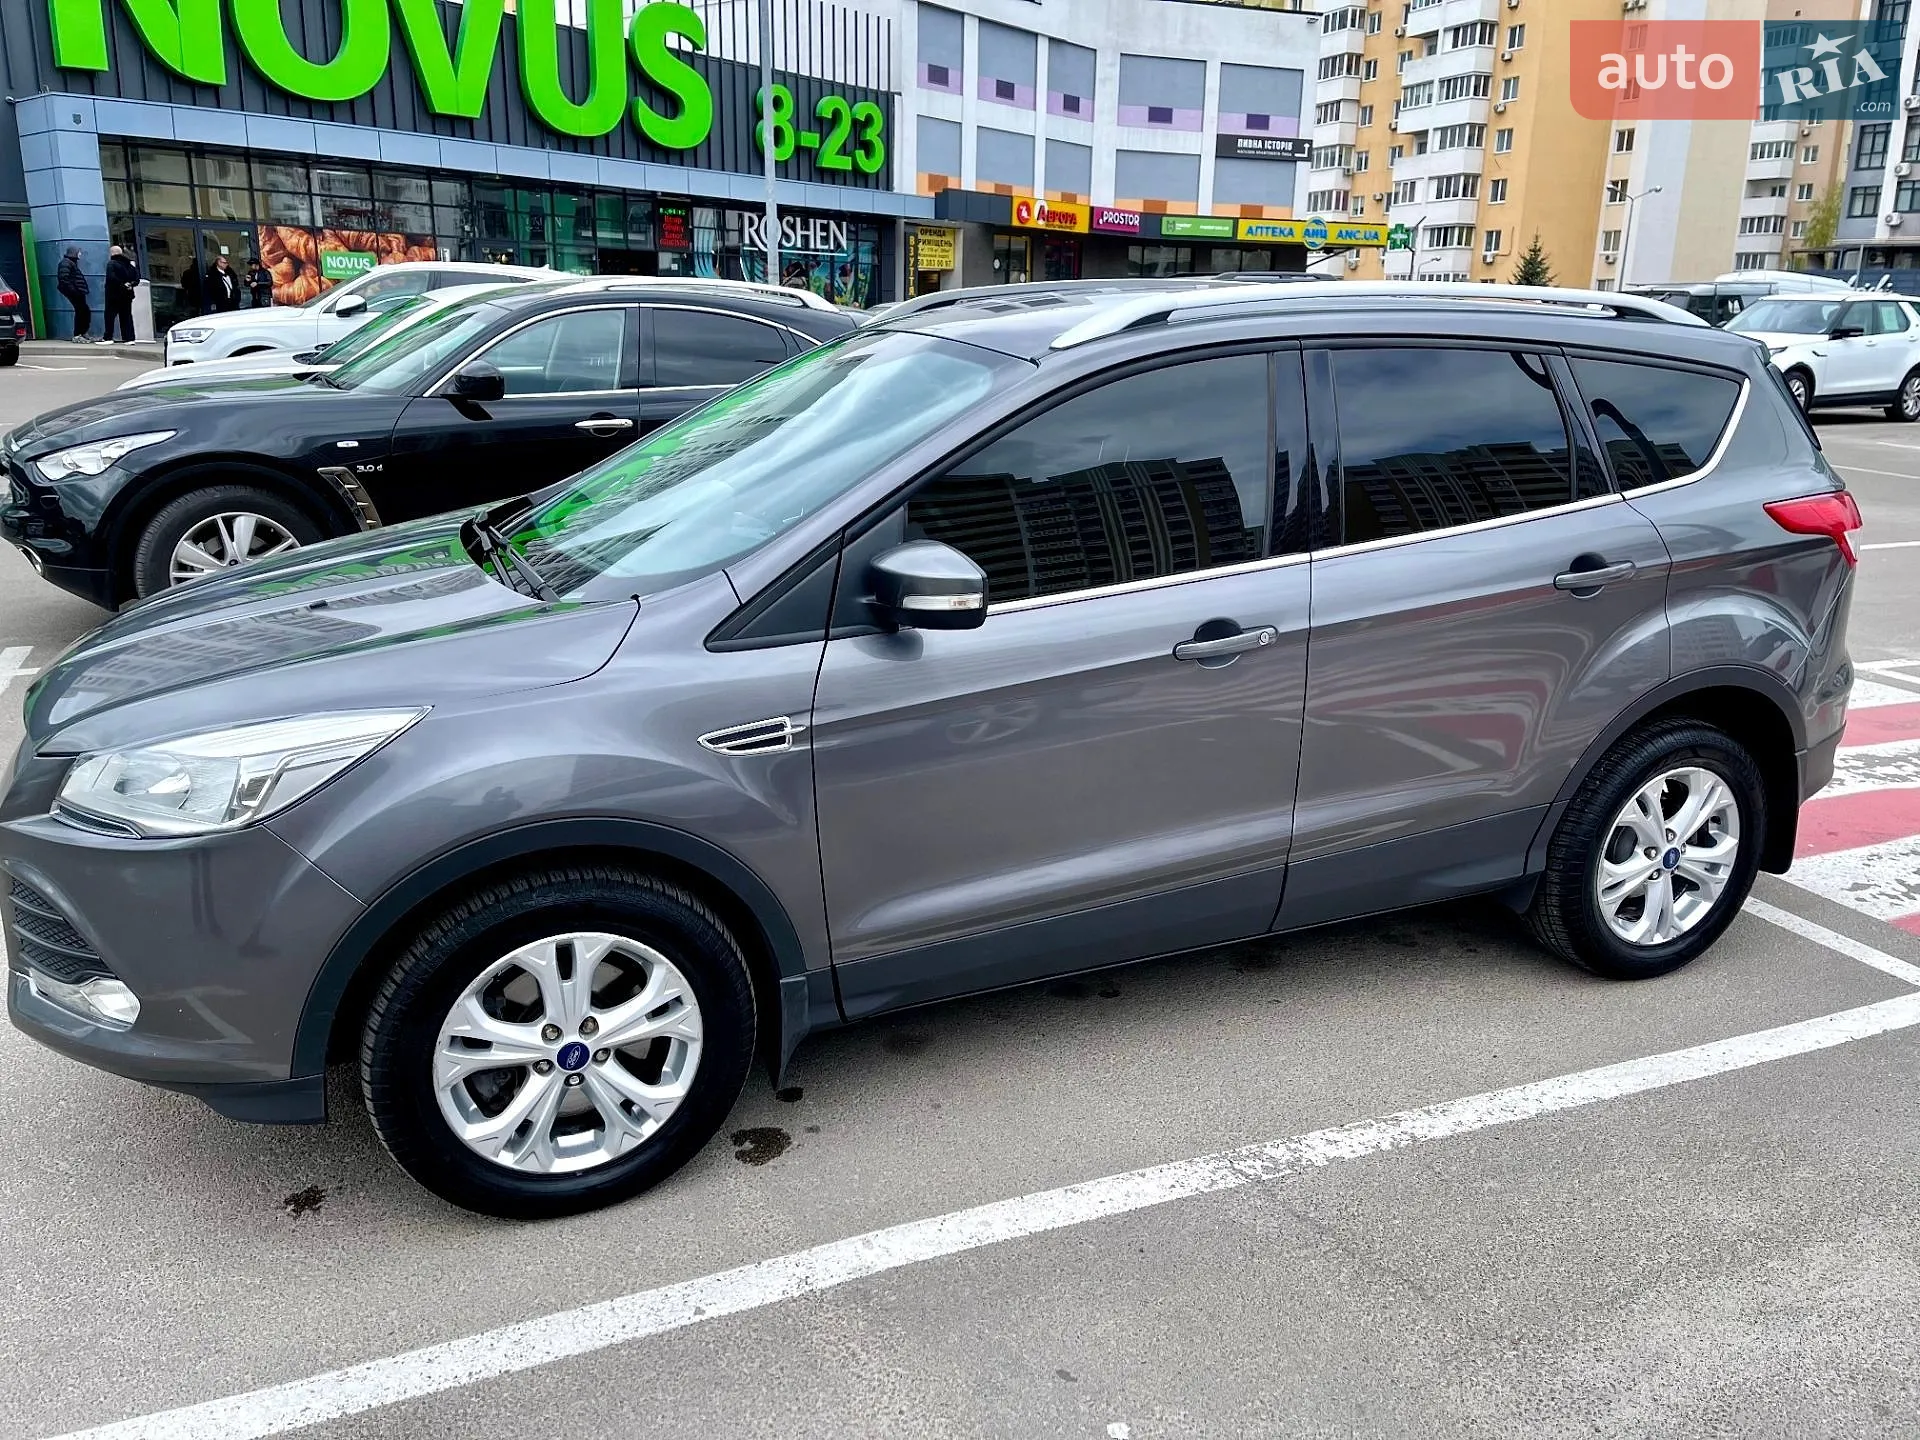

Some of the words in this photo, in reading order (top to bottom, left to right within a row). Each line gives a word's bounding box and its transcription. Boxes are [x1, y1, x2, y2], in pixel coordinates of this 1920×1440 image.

[756, 83, 885, 173] 8-23
[1237, 139, 1263, 149] ПИВНА
[920, 228, 946, 237] ОРЕНДА
[1246, 225, 1295, 238] АПТЕКА
[1336, 229, 1379, 241] ANC.UA
[326, 256, 371, 271] NOVUS
